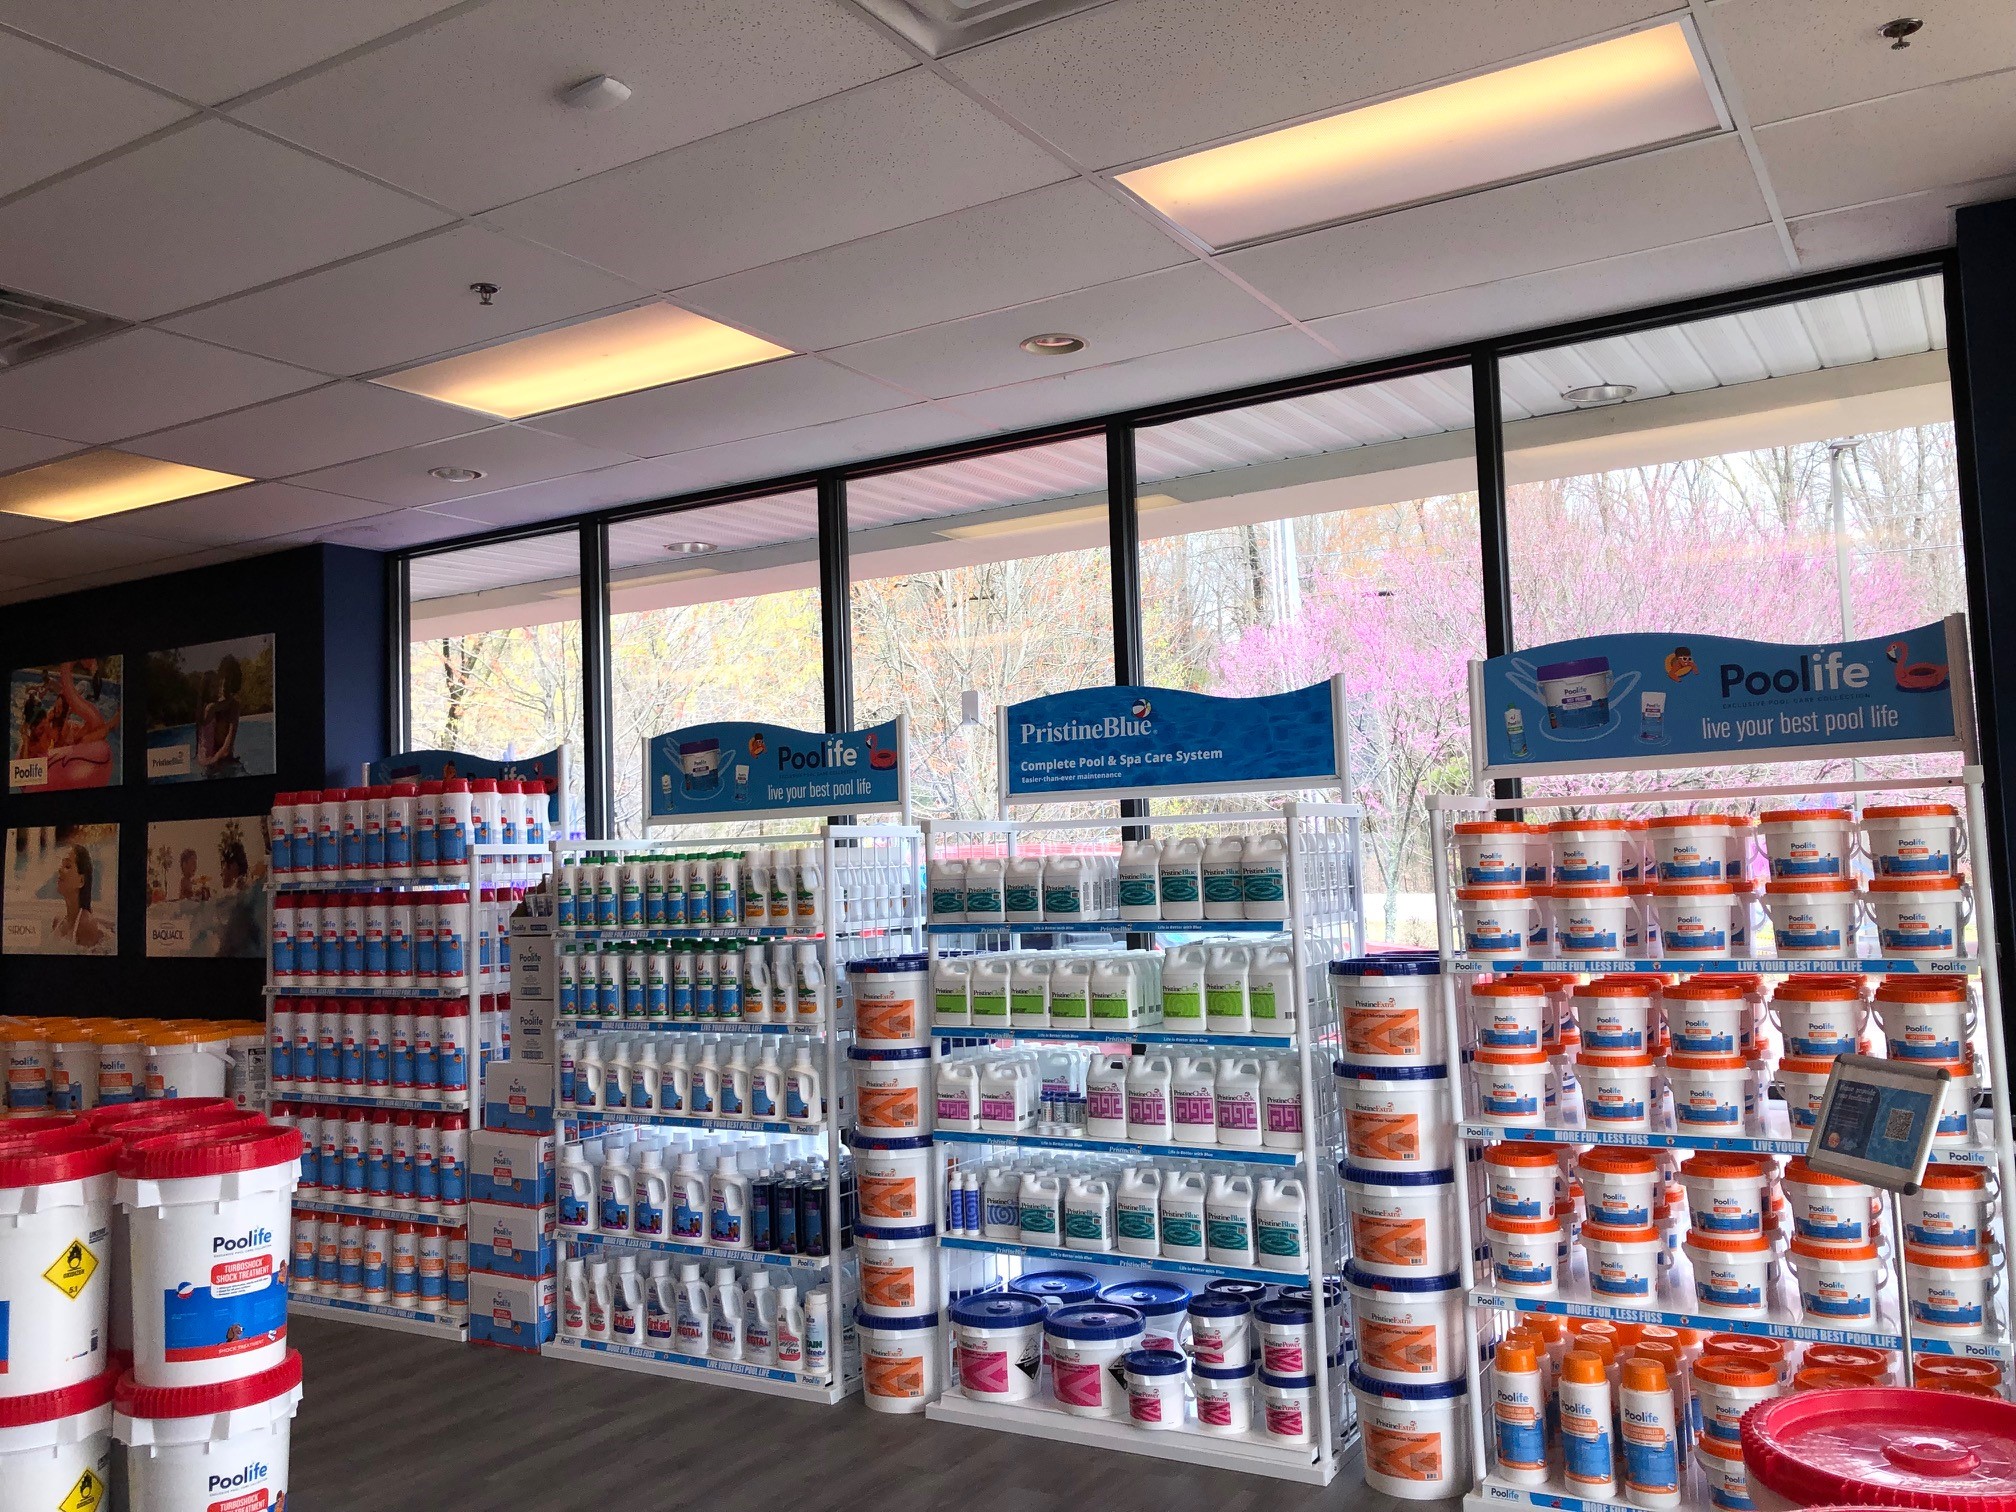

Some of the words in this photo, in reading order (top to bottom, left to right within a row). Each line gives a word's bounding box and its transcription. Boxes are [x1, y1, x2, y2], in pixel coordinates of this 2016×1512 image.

[1721, 651, 1870, 698] Poolife
[1723, 701, 1769, 709] EXCLUSIVE
[1769, 698, 1789, 706] POOL
[1818, 693, 1871, 702] COLLECTION
[1702, 717, 1730, 740] live
[1736, 718, 1774, 742] your
[1780, 711, 1819, 735] best
[1825, 706, 1864, 736] pool
[1871, 704, 1899, 728] life
[1020, 715, 1153, 745] PristineBlue
[778, 739, 858, 771] Poolife
[1021, 758, 1076, 773] Complete
[1078, 755, 1105, 769] Pool
[1107, 755, 1117, 766] &
[1120, 753, 1142, 768] Spa
[1145, 751, 1173, 764] Care
[1176, 748, 1223, 763] System
[14, 765, 43, 780] Poolife
[1021, 773, 1076, 784] Easier-than-ever
[1077, 770, 1122, 781] maintenance
[767, 784, 784, 801] live
[786, 786, 807, 803] your
[809, 781, 830, 798] best
[833, 778, 853, 799] pool
[856, 778, 871, 795] life
[1790, 841, 1816, 849] Poolife
[1898, 838, 1925, 846] Poolife
[1243, 867, 1281, 875] PristineBlue
[1477, 918, 1498, 926] Poolife
[1677, 915, 1702, 923] Poolife
[1788, 913, 1813, 921] Poolife
[1898, 913, 1926, 921] Poolife
[152, 929, 184, 941] BAQUACIL
[519, 953, 541, 962] Poolife
[1455, 962, 1482, 971] Poolife
[1542, 961, 1568, 971] MORE
[1590, 961, 1612, 971] LESS
[1613, 961, 1636, 971] FUSS
[1738, 961, 1758, 971] LIVE
[1759, 961, 1786, 971] YOUR
[1787, 961, 1810, 971] BEST
[1813, 961, 1840, 971] POOL
[1842, 961, 1863, 971] LIFE
[1931, 961, 1967, 971] Poolife
[1355, 999, 1395, 1008] PristineExtra
[520, 1016, 543, 1026] Poolife
[1809, 1022, 1834, 1030] Poolife
[1905, 1024, 1933, 1032] Poolife
[1174, 1089, 1211, 1097] PristineCheck
[1598, 1086, 1621, 1094] Poolife
[1690, 1089, 1713, 1098] Poolife
[1217, 1093, 1255, 1102] PristineCheck
[1355, 1102, 1394, 1112] PristineExtra
[1466, 1128, 1494, 1137] Poolife
[1555, 1131, 1580, 1142] MORE
[1602, 1133, 1625, 1144] LESS
[1626, 1134, 1649, 1146] FUSS
[1753, 1140, 1772, 1151] LIVE
[1774, 1141, 1798, 1153] YOUR
[1949, 1152, 1985, 1162] Poolife
[1603, 1192, 1626, 1200] Poolife
[1118, 1202, 1154, 1211] PristineBlue
[1713, 1197, 1738, 1206] Poolife
[1162, 1209, 1200, 1218] PristineBlue
[1809, 1204, 1834, 1213] Poolife
[1208, 1212, 1246, 1222] PristineBlue
[1923, 1210, 1950, 1219] Poolife
[1258, 1218, 1297, 1228] PristineBlue
[213, 1227, 272, 1253] Poolife
[224, 1258, 263, 1273] TURBOSHOCK
[216, 1272, 238, 1283] SHOCK
[239, 1265, 270, 1280] TREATMENT
[1819, 1280, 1845, 1289] Poolife
[1928, 1287, 1955, 1297] Poolife
[1477, 1297, 1505, 1307] Poolife
[1566, 1304, 1590, 1315] MORE
[1615, 1308, 1637, 1320] LESS
[1639, 1311, 1662, 1323] FUSS
[1769, 1324, 1790, 1337] LIVE
[1791, 1327, 1818, 1340] YOUR
[1820, 1329, 1844, 1342] BEST
[1847, 1332, 1873, 1345] POOL
[1875, 1335, 1898, 1348] LIFE
[1965, 1345, 2001, 1356] Poolife
[1497, 1389, 1529, 1403] Poolife
[1561, 1399, 1592, 1415] Poolife
[1624, 1408, 1659, 1423] Poolife
[208, 1461, 268, 1492] Poolife
[1491, 1488, 1519, 1499] Poolife
[220, 1494, 259, 1511] TURBOSHOCK
